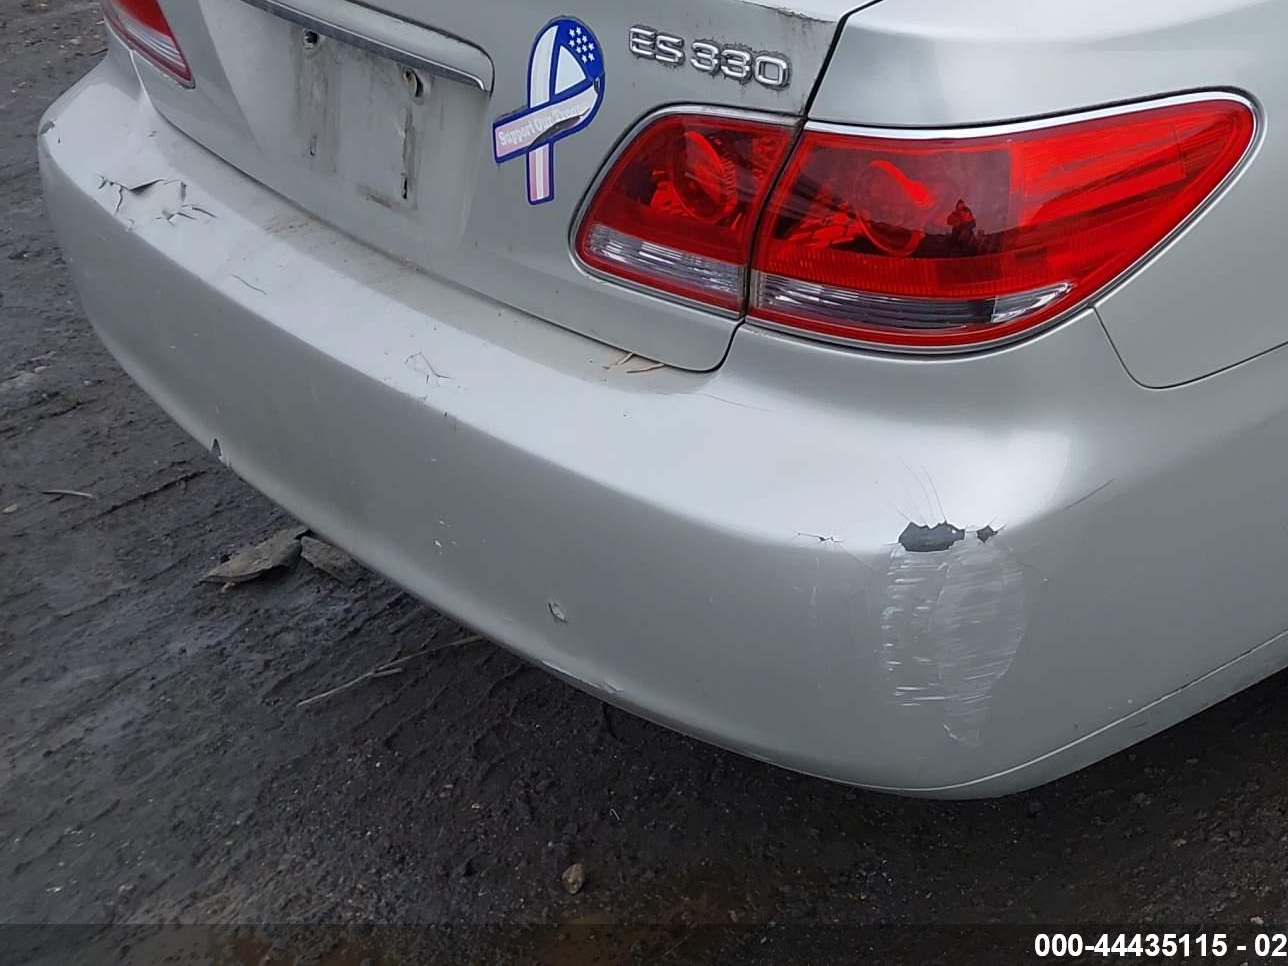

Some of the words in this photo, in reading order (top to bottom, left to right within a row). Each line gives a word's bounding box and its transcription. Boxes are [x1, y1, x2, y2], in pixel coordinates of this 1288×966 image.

[628, 24, 685, 65] ES
[690, 38, 792, 89] 330
[498, 119, 535, 146] Support
